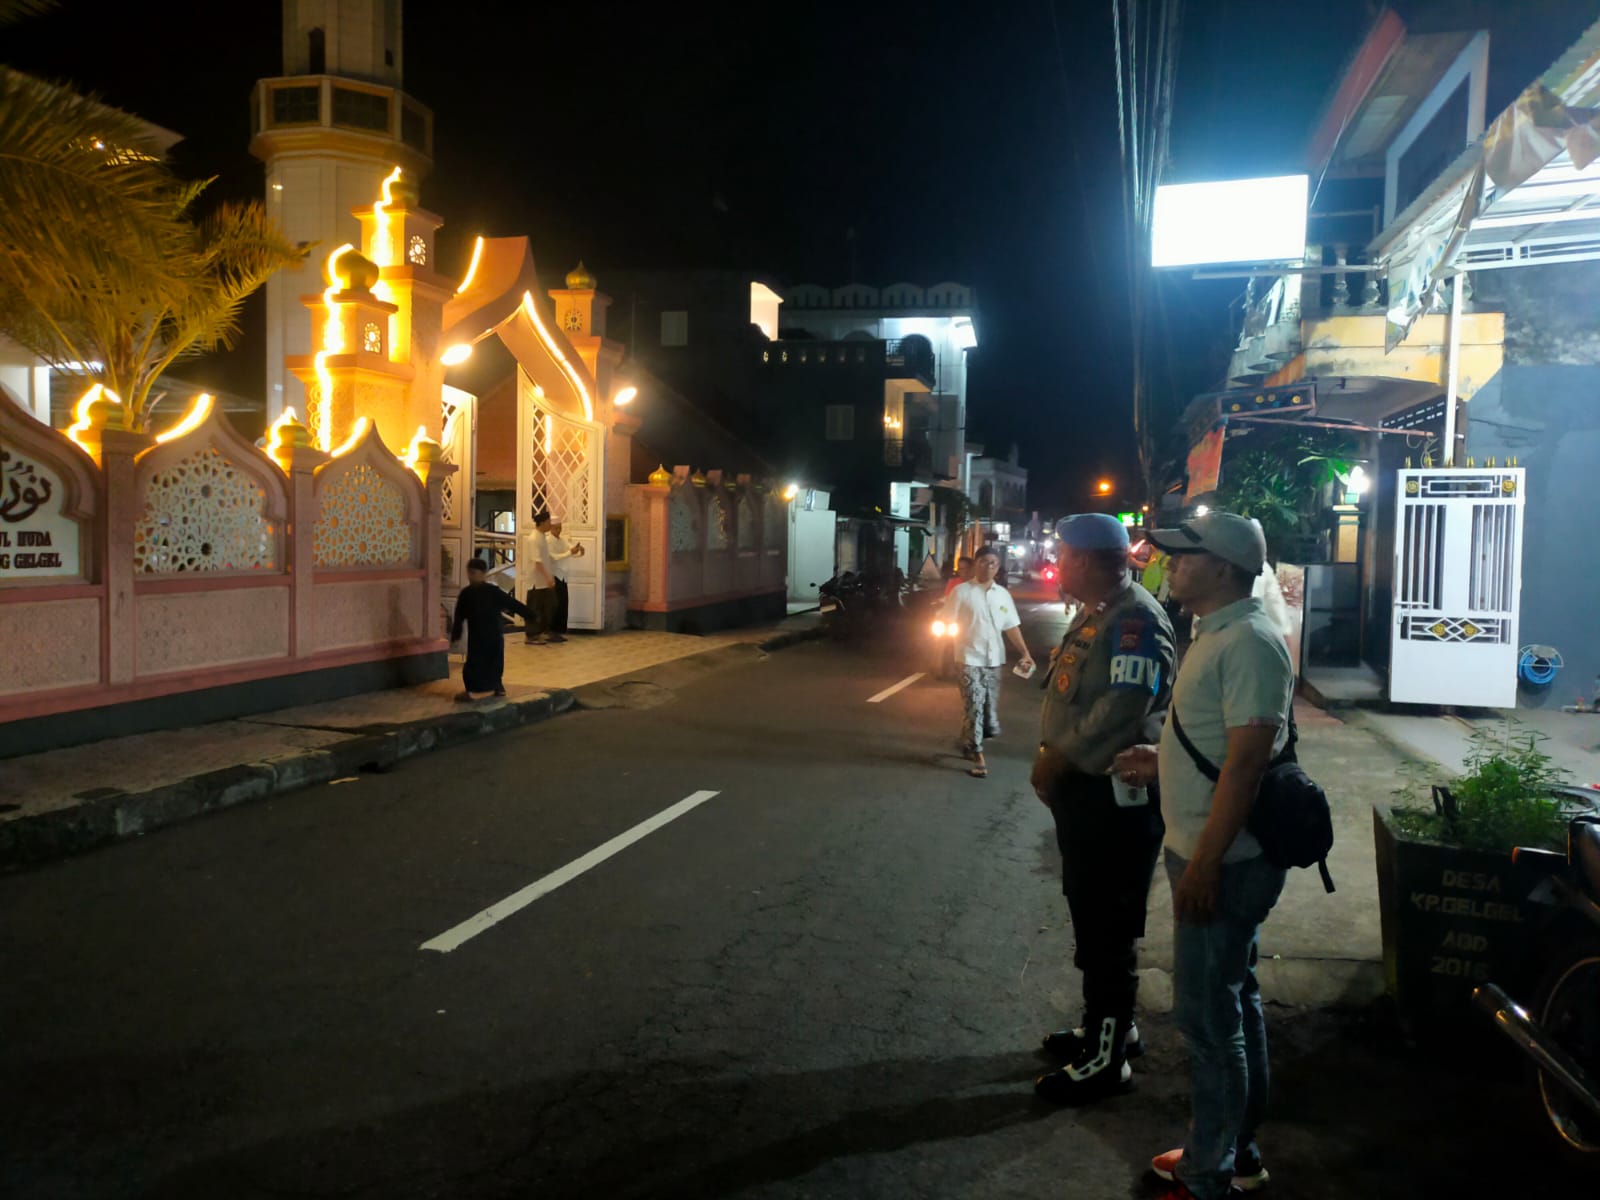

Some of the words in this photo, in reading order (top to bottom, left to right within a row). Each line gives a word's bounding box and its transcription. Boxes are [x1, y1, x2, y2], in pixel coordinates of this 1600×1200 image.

[17, 531, 52, 546] HUDA
[14, 553, 62, 568] GELGEL
[1442, 869, 1502, 893] DESA
